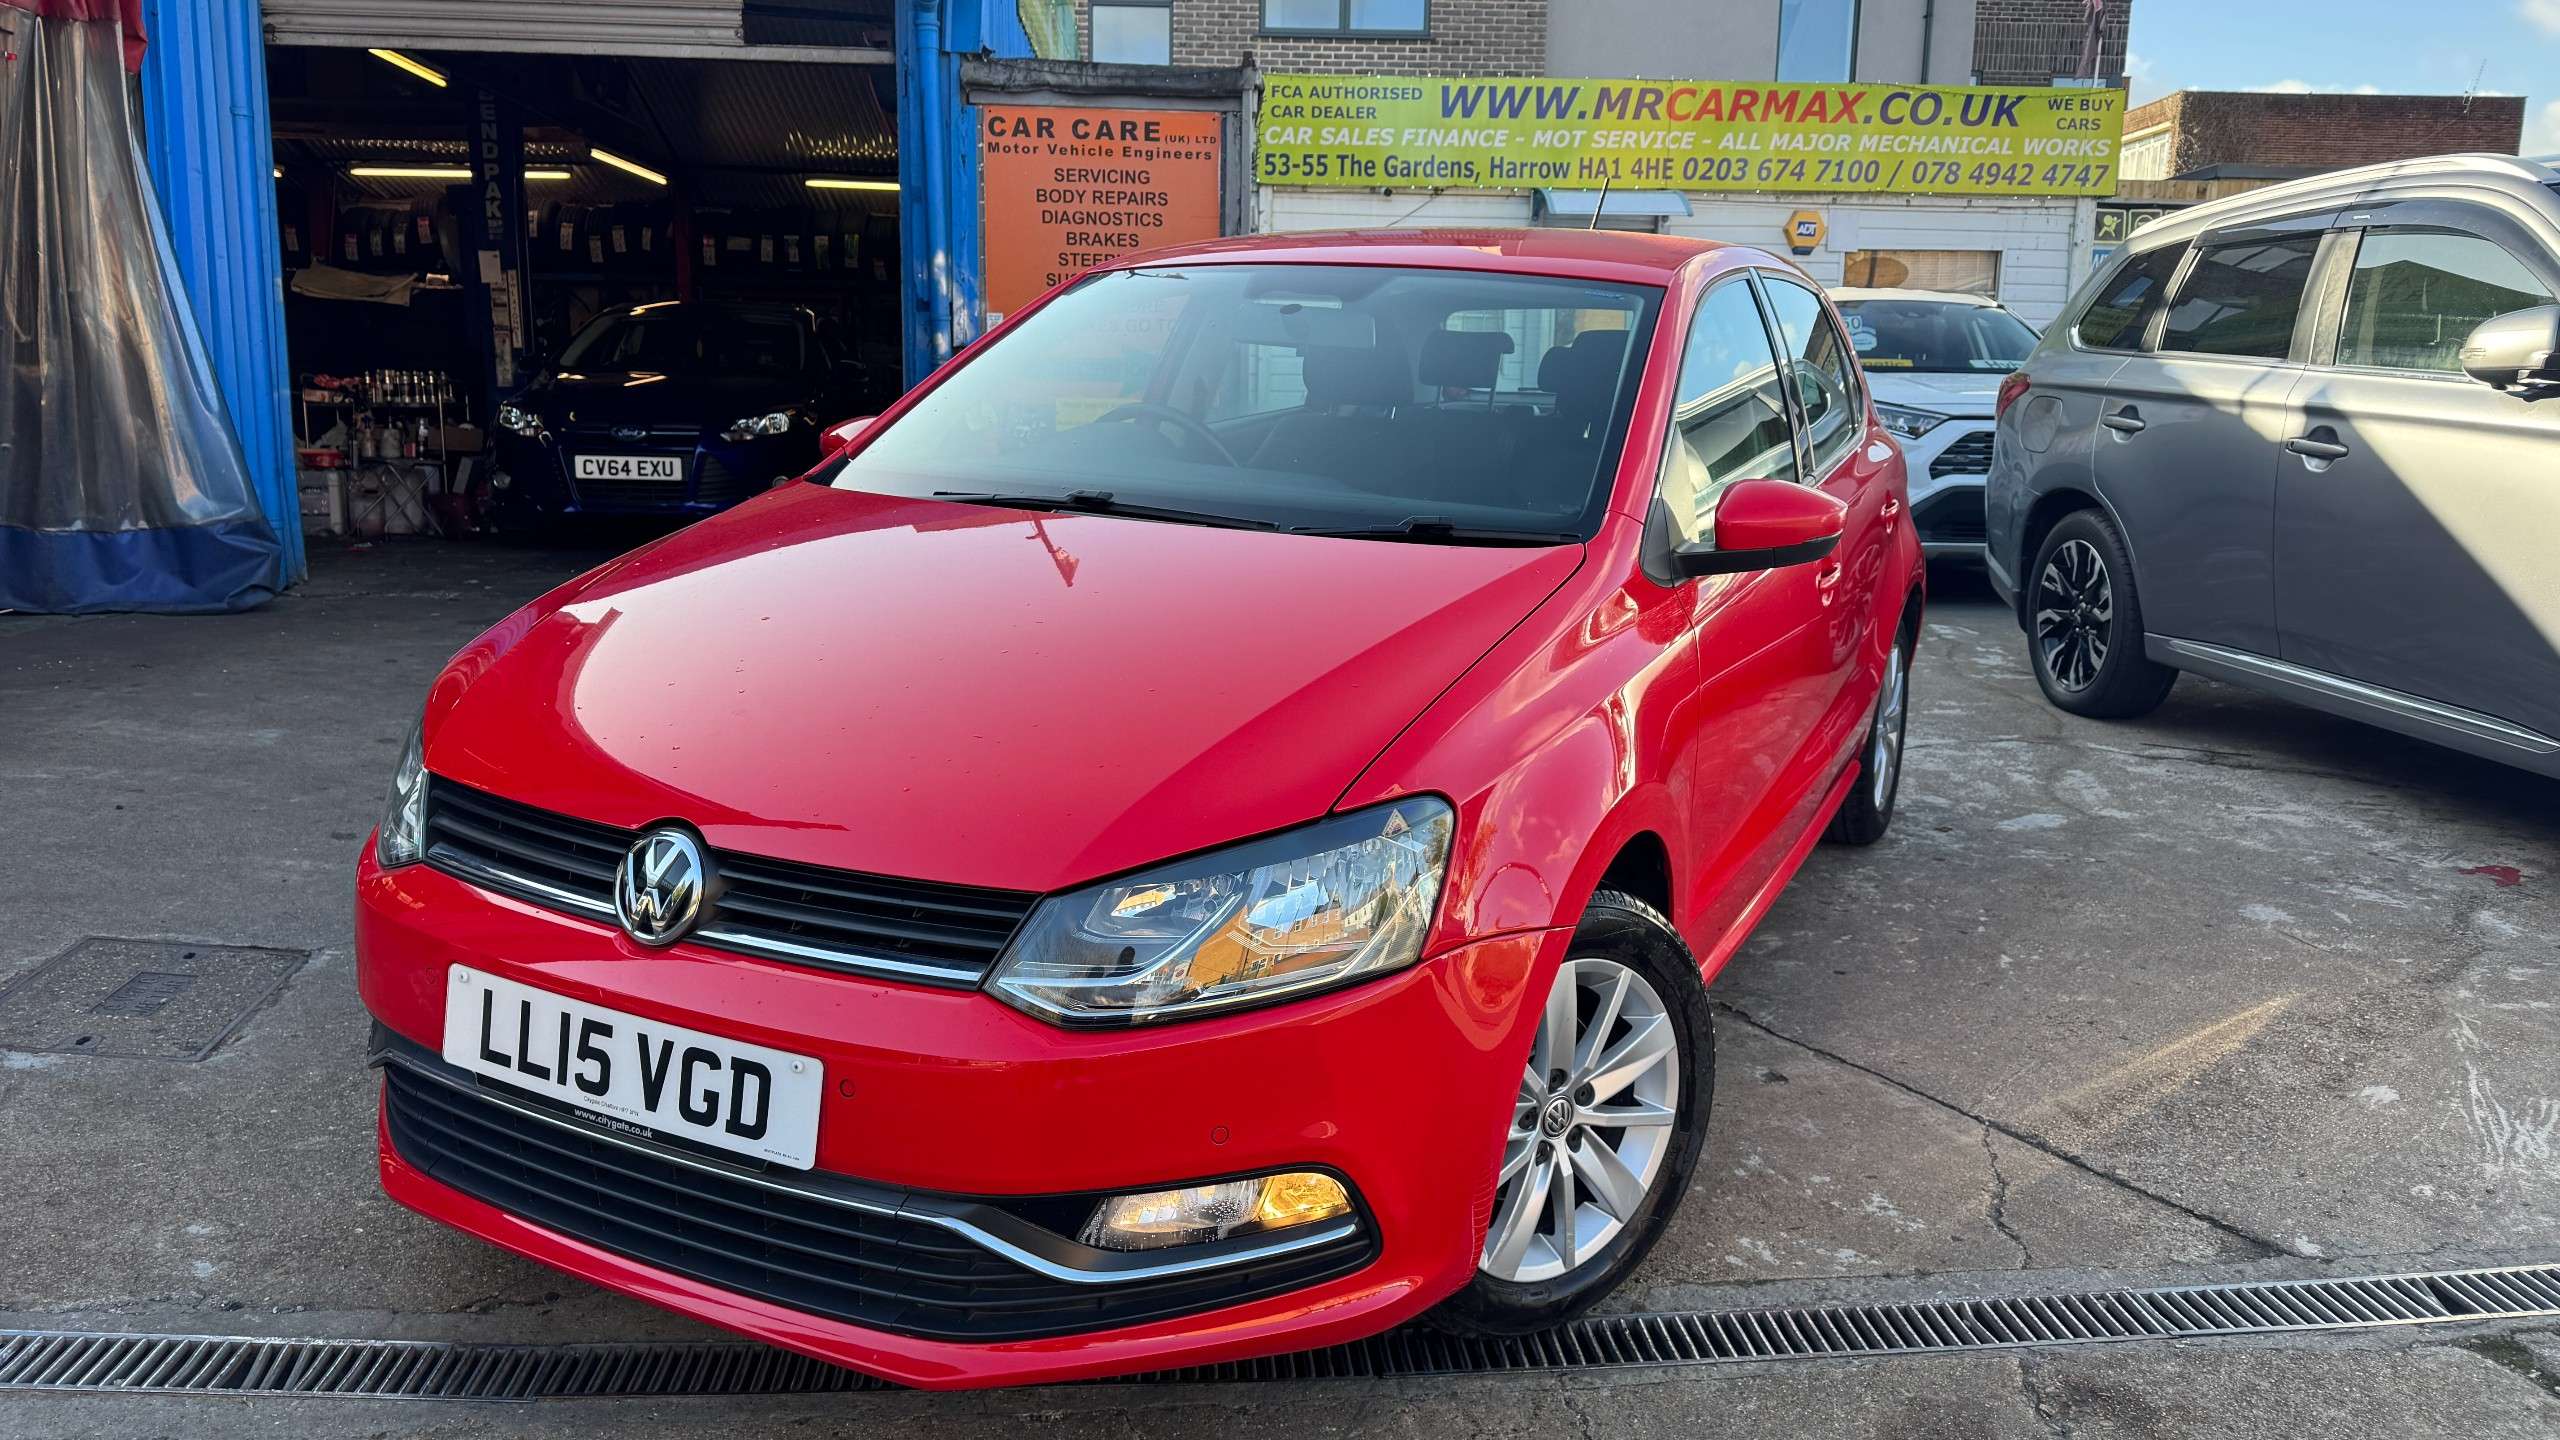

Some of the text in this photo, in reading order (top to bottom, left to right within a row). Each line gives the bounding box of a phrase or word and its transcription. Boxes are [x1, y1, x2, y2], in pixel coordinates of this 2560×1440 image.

[1271, 85, 1423, 100] FCA AUTHORISED
[1271, 104, 1377, 119] CAR DEALER
[1441, 84, 2027, 127] WWW.MRCARMAX.CO.UK
[2048, 99, 2114, 112] WE BUY
[988, 115, 1217, 145] CAR CARE (UK) LTD
[2056, 117, 2102, 131] CARS
[1264, 126, 1313, 145] CAR
[1319, 127, 1394, 146] SALES
[1401, 128, 1509, 147] FINANCE
[1532, 130, 1586, 148] MOT
[1591, 130, 1696, 149] SERVICE
[1718, 132, 1761, 150] ALL
[1769, 132, 1853, 152] MAJOR
[1858, 134, 2013, 155] MECHANICAL
[2023, 137, 2111, 157] WORKS
[988, 142, 1213, 161] Motor Vehicle Engineers
[1054, 168, 1151, 184] SERVICING
[1264, 152, 2110, 188] 53-55 The Gardens, Harrow HA1 4HE 0203 674 7100 / 078 4942 4747
[1036, 188, 1169, 206] BODY REPAIRS
[1042, 210, 1164, 227] DIAGNOSTICS
[1796, 223, 1817, 235] ADT
[1066, 232, 1140, 247] BRAKES
[1058, 252, 1121, 267] STEE
[583, 459, 674, 477] CV64 EXU
[480, 988, 772, 1141] LL15 VGD
[574, 1107, 653, 1139] www.citygate.co.uk
